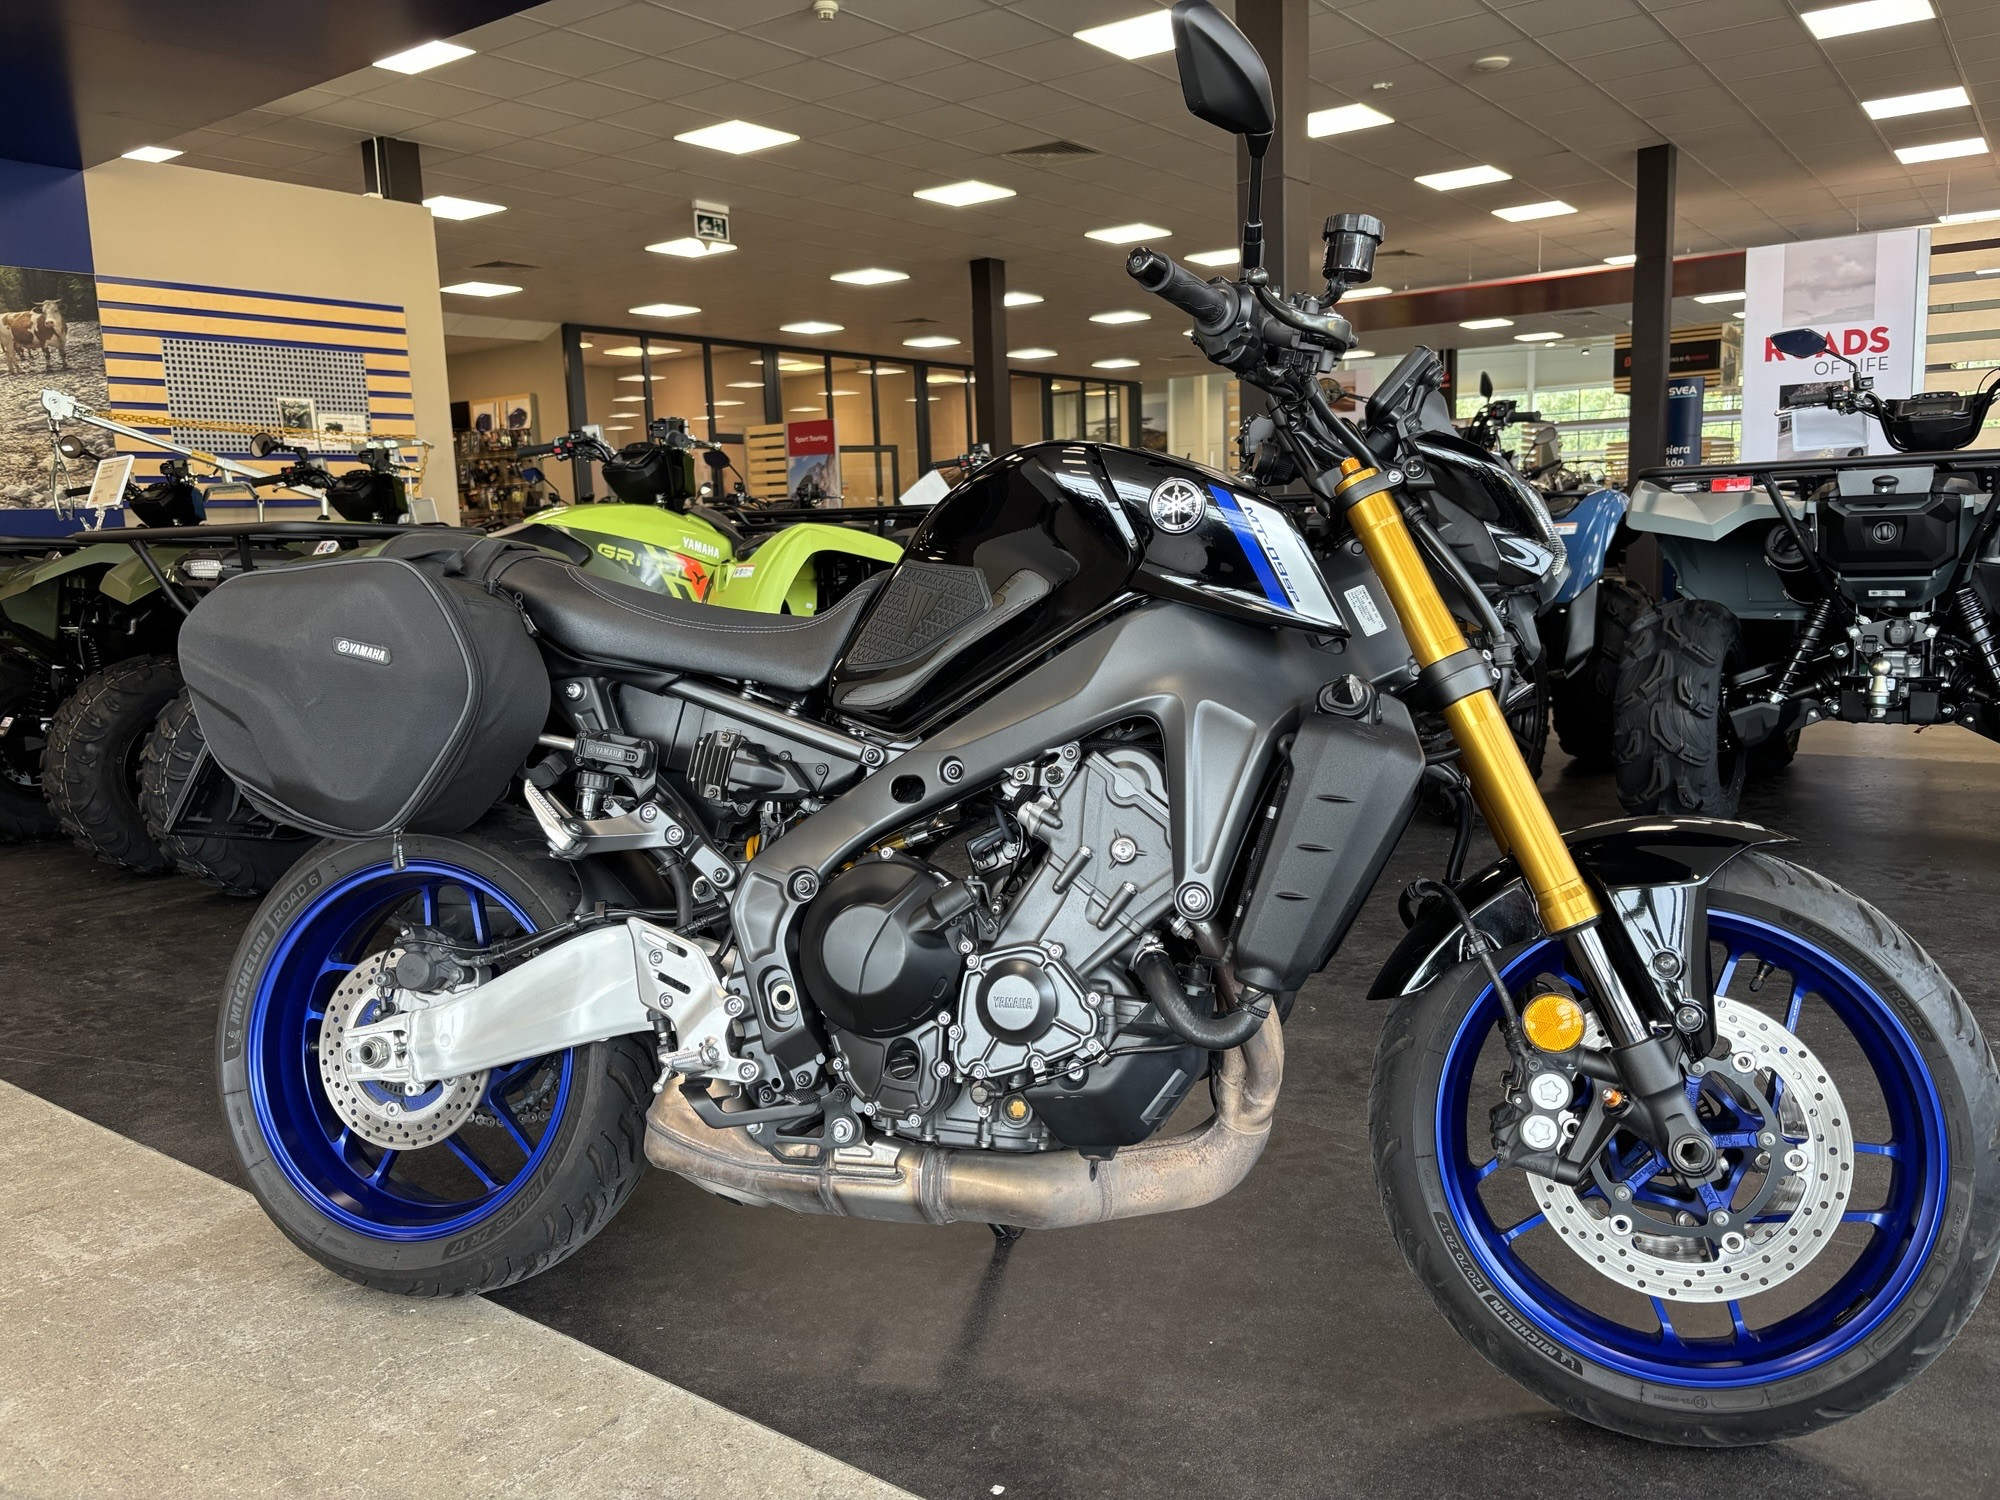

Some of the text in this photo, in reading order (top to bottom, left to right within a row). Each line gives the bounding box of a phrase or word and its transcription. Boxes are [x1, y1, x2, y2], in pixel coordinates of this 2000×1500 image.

[1765, 327, 1890, 362] RADS
[1814, 356, 1889, 375] OF LIFE
[1668, 386, 1697, 396] SVEA
[682, 536, 720, 559] YAMAHA
[349, 643, 386, 661] YAMAHA
[596, 746, 622, 759] YAMAHA
[229, 873, 319, 1025] MICHELIN ROAD 6
[993, 996, 1033, 1009] YAMAHA
[1891, 990, 1921, 1027] ROAD
[1919, 1030, 1931, 1039] 6
[1440, 1220, 1558, 1356] MICHELIN 120/70 ZR 17
